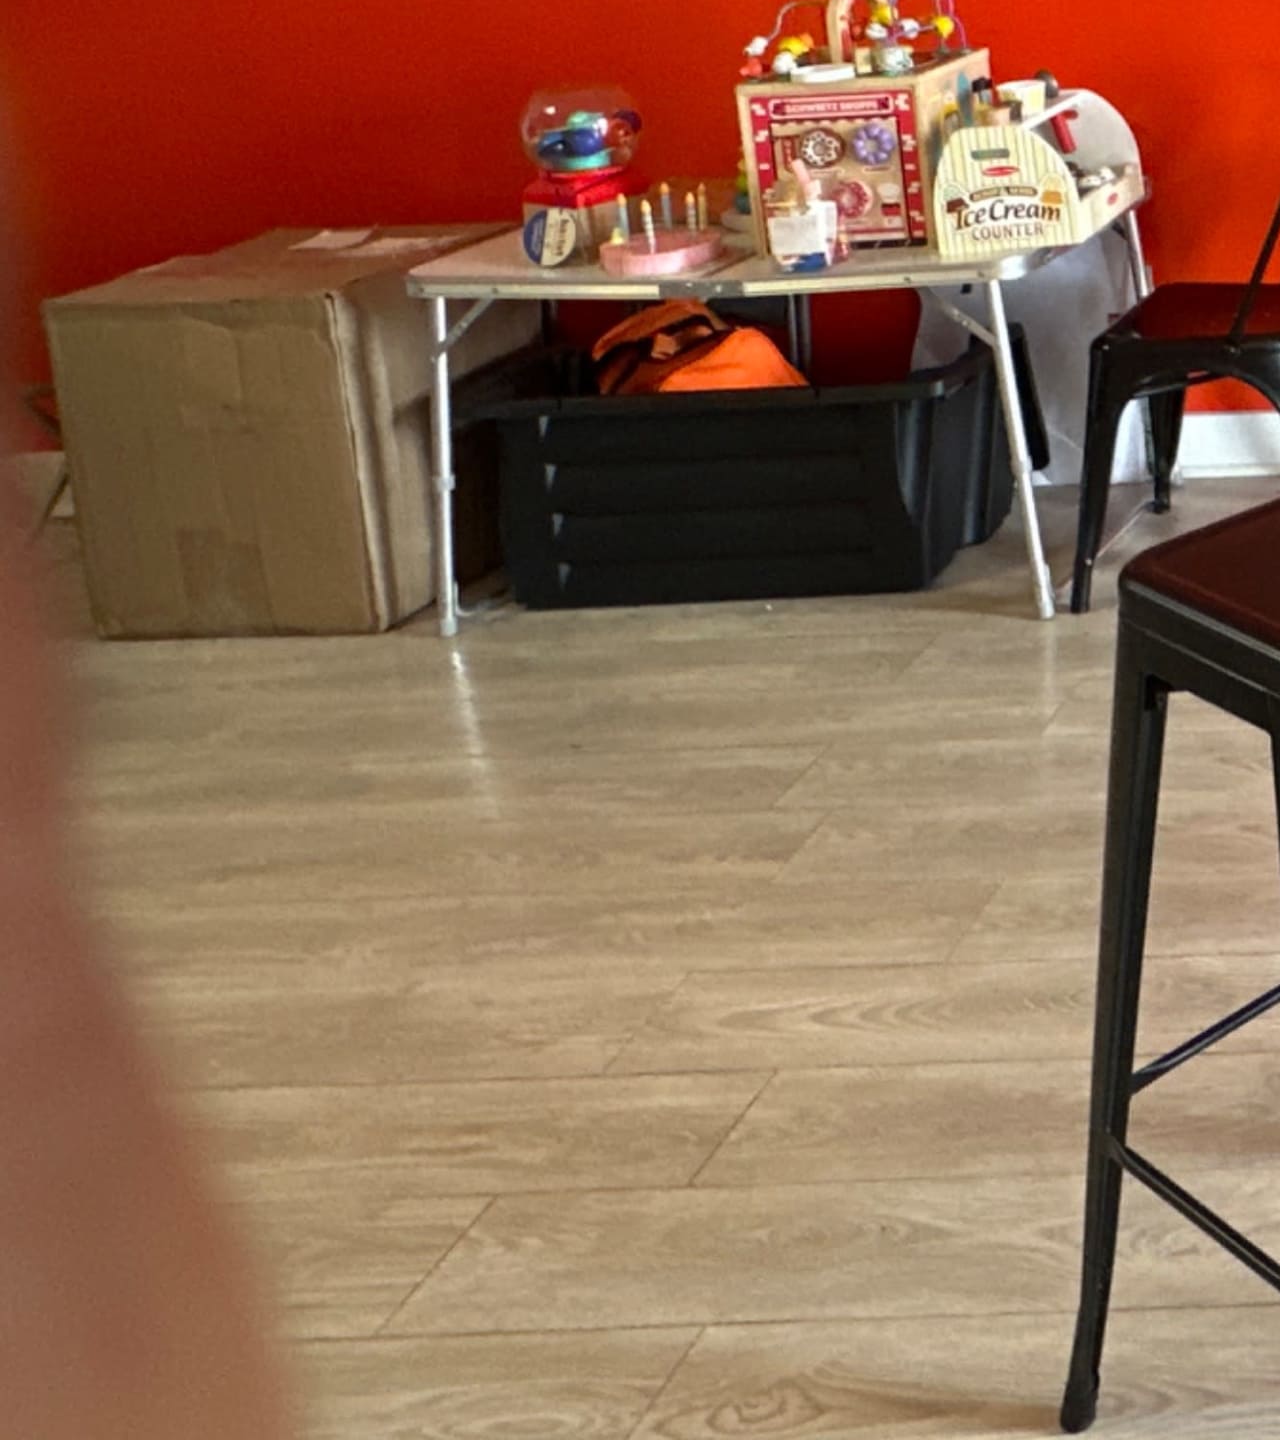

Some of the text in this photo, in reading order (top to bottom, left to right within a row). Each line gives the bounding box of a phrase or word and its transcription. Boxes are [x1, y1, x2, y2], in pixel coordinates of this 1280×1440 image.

[954, 199, 1061, 230] Ice Cream
[972, 221, 1044, 241] COUNTER
